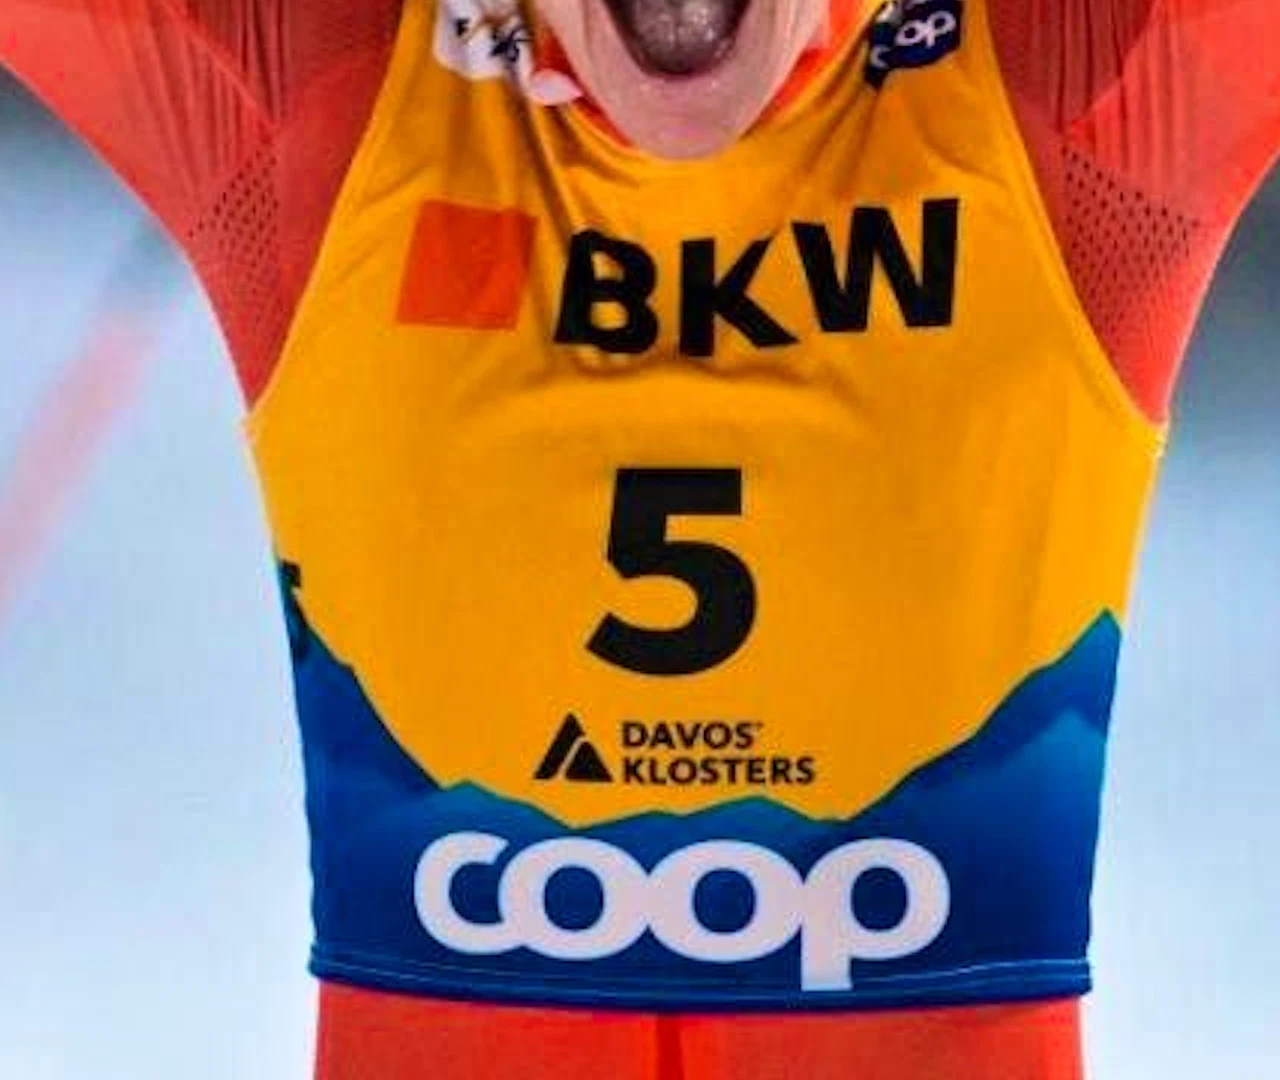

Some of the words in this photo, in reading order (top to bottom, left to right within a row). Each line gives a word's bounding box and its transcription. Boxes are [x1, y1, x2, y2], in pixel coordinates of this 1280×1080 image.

[554, 197, 959, 358] BKW
[585, 468, 757, 677] 5
[622, 755, 817, 785] KLOSTERS
[413, 830, 951, 991] coop
